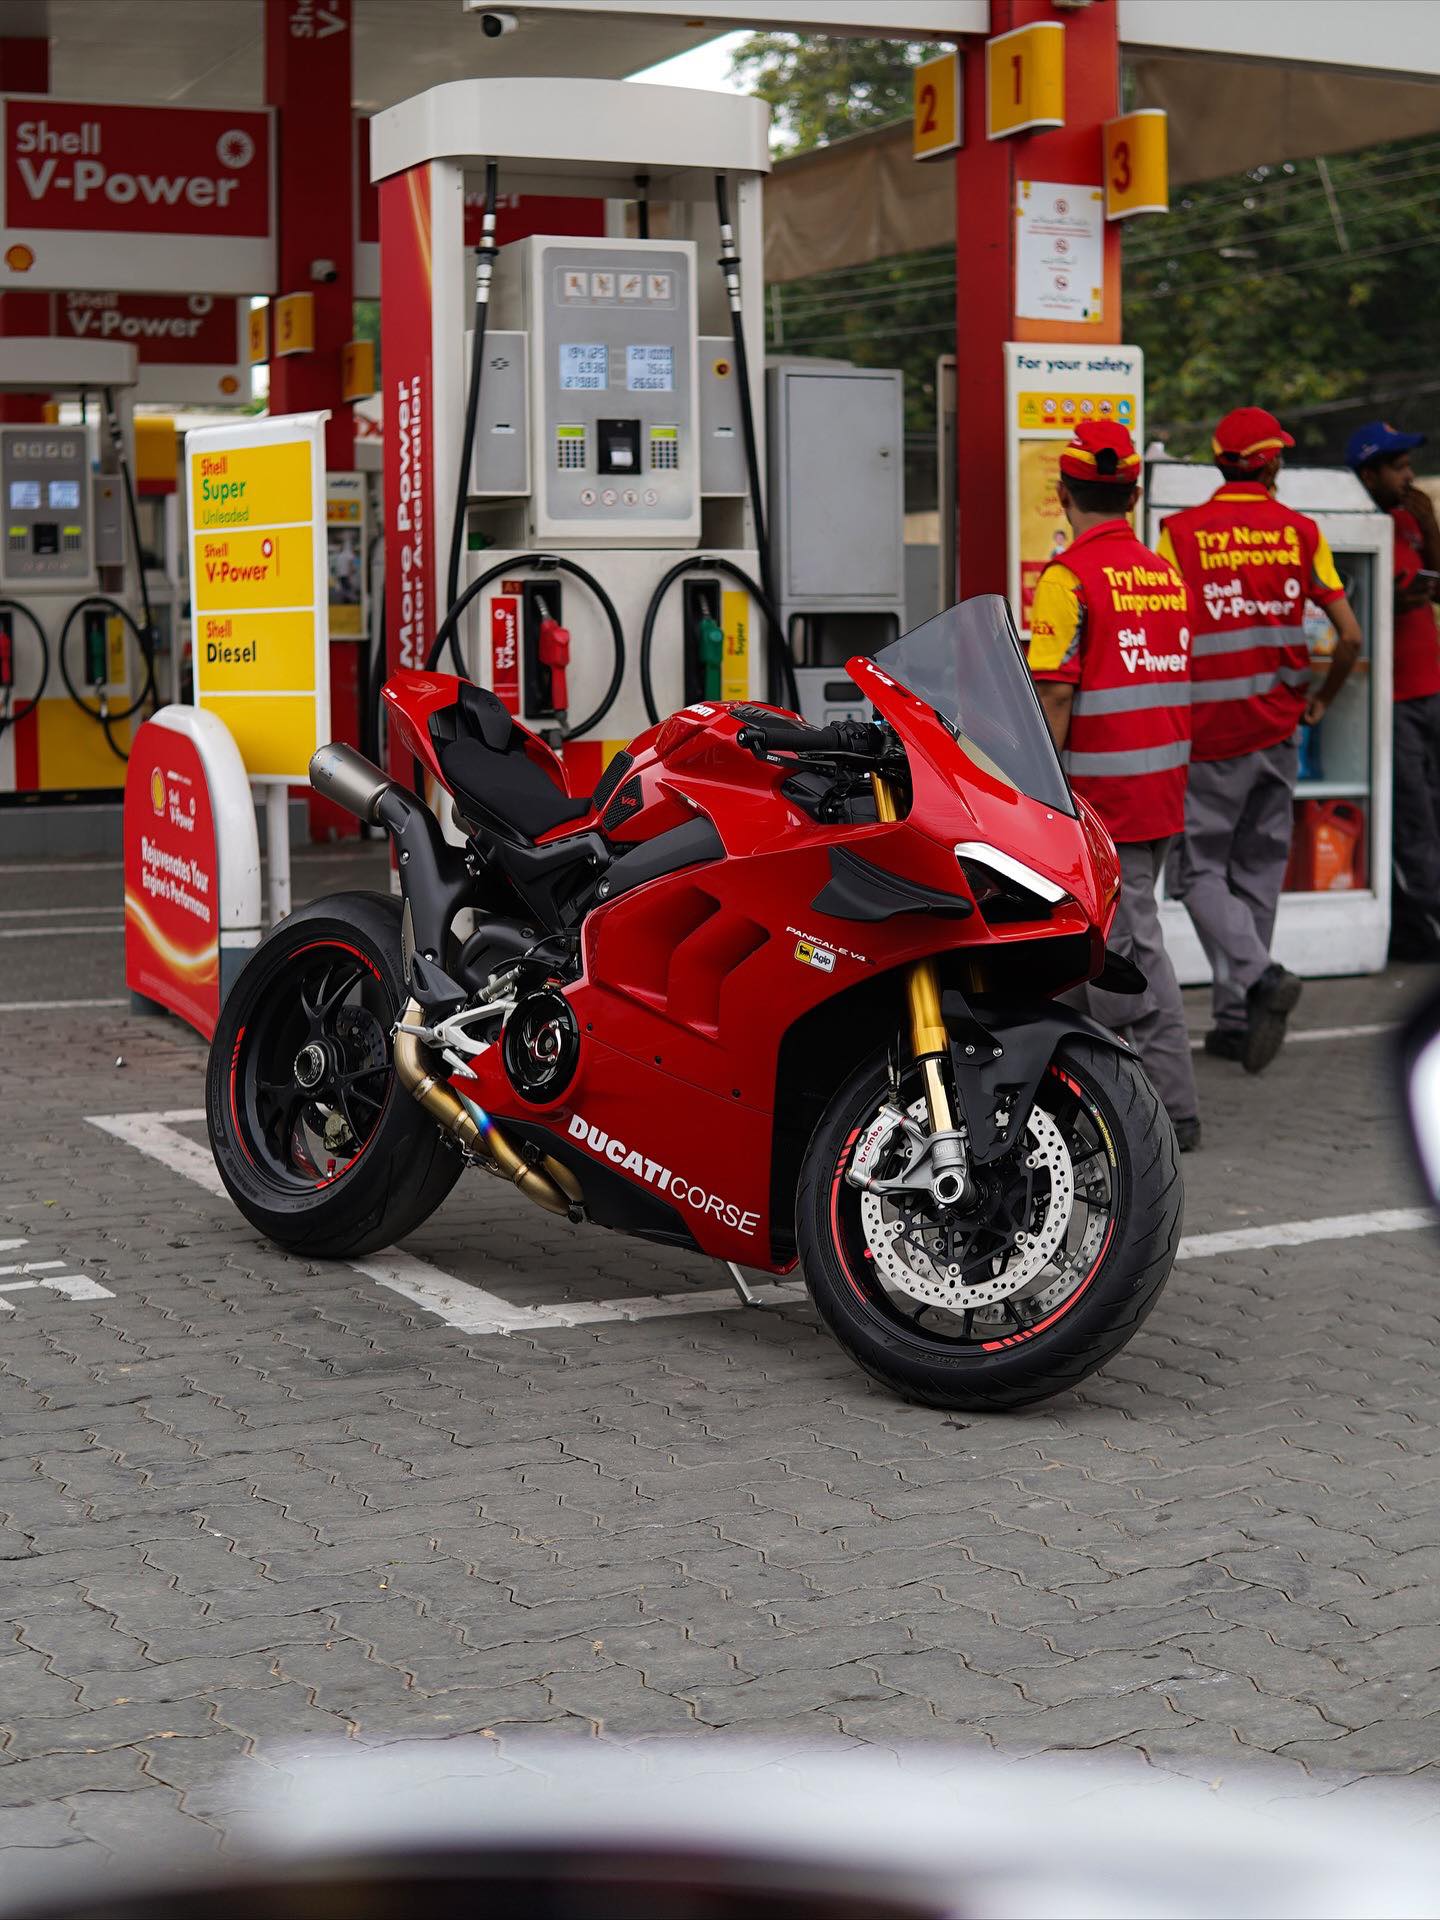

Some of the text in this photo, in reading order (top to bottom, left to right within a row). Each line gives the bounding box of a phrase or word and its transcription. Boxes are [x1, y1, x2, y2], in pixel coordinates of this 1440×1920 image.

[1011, 54, 1022, 105] 1
[919, 84, 937, 135] 2
[15, 122, 101, 154] Shell
[16, 158, 239, 207] V-Power
[1112, 142, 1132, 194] 3
[67, 309, 204, 338] V-Power
[1017, 355, 1133, 376] For your safety
[201, 457, 228, 477] Shell
[409, 375, 423, 570] Acceleration
[202, 479, 248, 505] Super
[202, 506, 250, 525] Unleaded
[397, 380, 413, 669] More Power
[204, 543, 229, 559] Shell
[1194, 525, 1301, 551] Try New &
[205, 561, 269, 584] V-Power
[1200, 545, 1302, 572] Improved
[1102, 566, 1133, 592] Try
[1131, 565, 1169, 588] New
[1203, 578, 1243, 600] Shell
[206, 620, 233, 639] Shell
[503, 612, 516, 670] V-Power
[735, 621, 746, 657] Super
[207, 640, 257, 664] Diesel
[865, 663, 896, 688] V4
[169, 804, 195, 833] V-Power
[141, 834, 210, 893] Rejuvenates Your
[141, 865, 211, 923] Engine's Performance
[785, 925, 867, 962] PANIGALE V4
[812, 951, 832, 966] Agip
[857, 1124, 884, 1164] brembo
